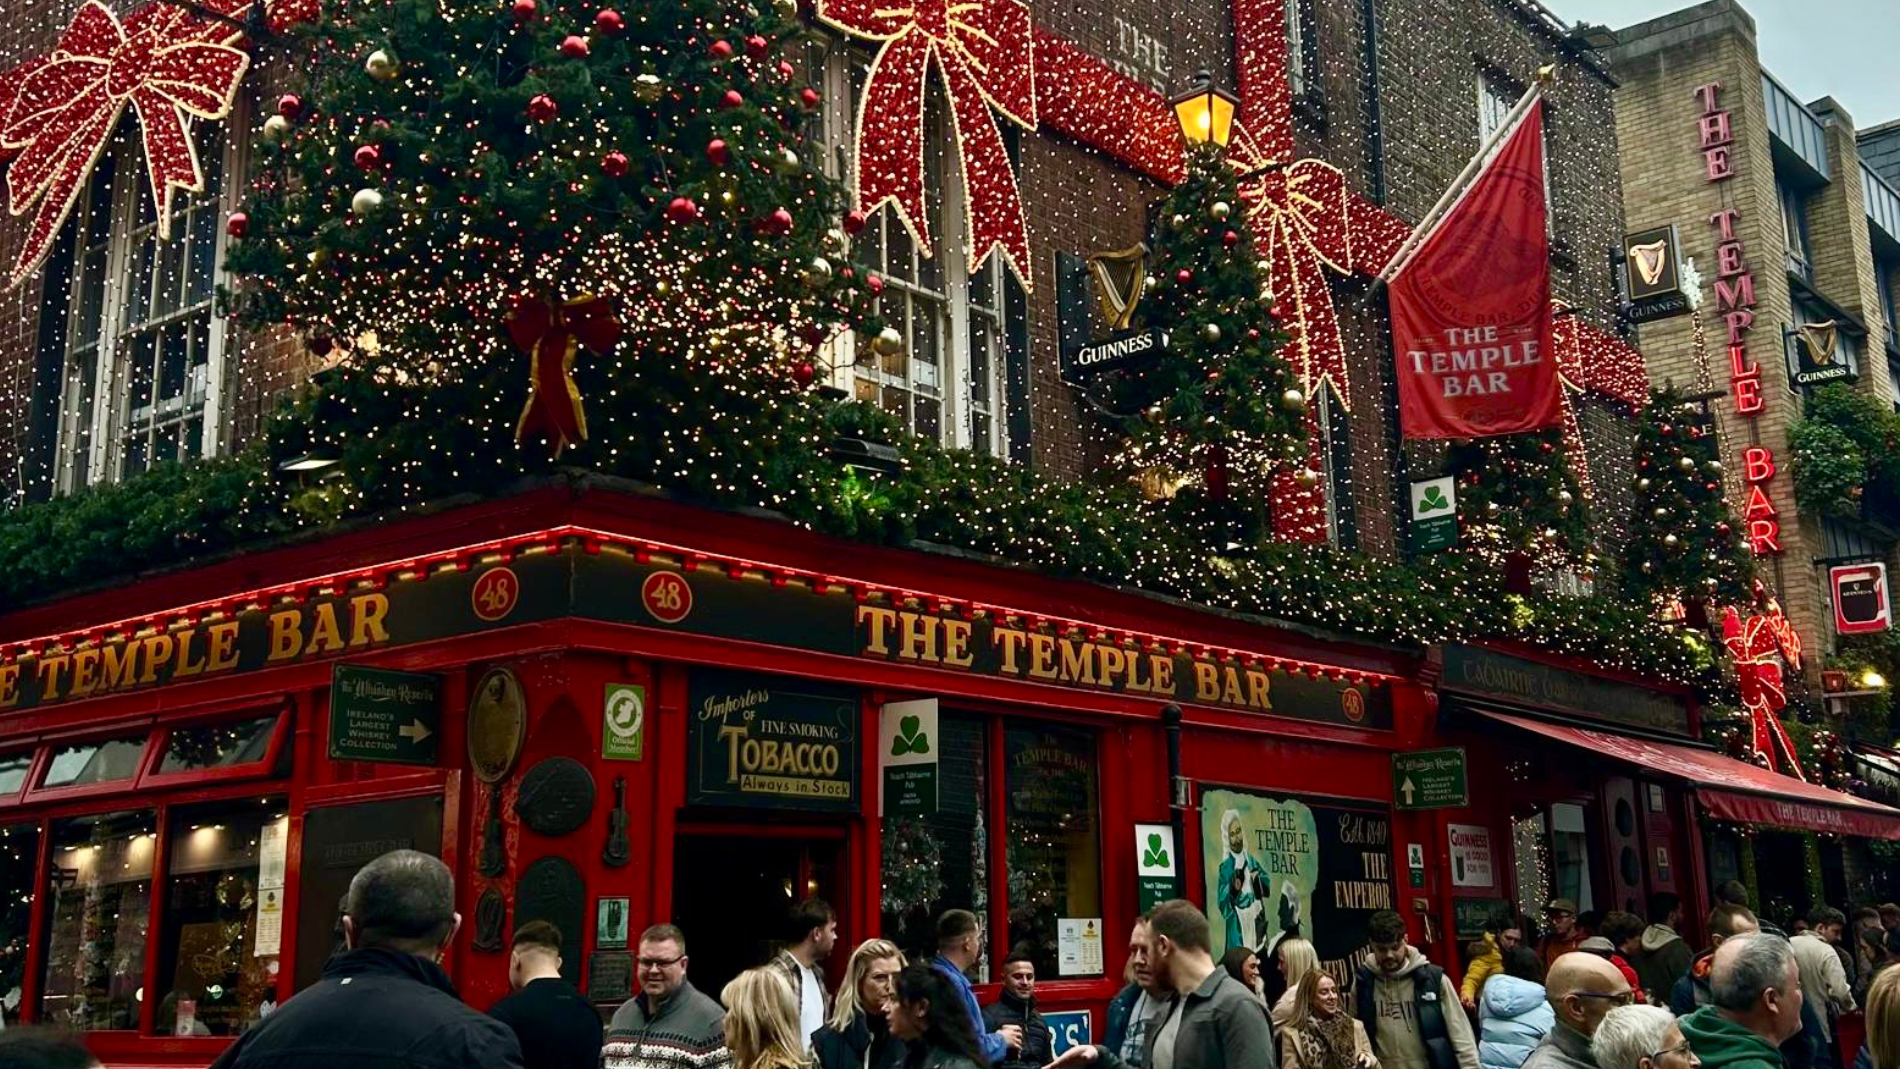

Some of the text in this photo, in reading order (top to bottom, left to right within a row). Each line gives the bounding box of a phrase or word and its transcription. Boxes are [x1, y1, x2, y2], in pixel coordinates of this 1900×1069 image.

[1114, 17, 1170, 80] THE
[1629, 299, 1686, 320] GUINNESS
[1693, 79, 1780, 552] THE TEMPLE BAR
[1444, 325, 1499, 346] THE
[1079, 332, 1153, 366] GUINNESS
[1406, 339, 1542, 374] TEMPLE
[1442, 371, 1512, 398] BAR
[1797, 365, 1847, 384] GUINNESS
[480, 573, 509, 611] 48
[650, 576, 682, 610] 48
[37, 620, 242, 700] TEMPLE
[267, 592, 391, 661] BAR
[858, 604, 1273, 709] THE TEMPLE BAR
[347, 708, 395, 720] IRELAND'S
[698, 688, 769, 724] Importers
[743, 710, 756, 721] OF
[348, 728, 392, 740] WHISKEY
[349, 718, 391, 731] LARGEST
[761, 719, 839, 739] FINE SMOKING
[340, 737, 398, 750] COLLECTION
[717, 725, 840, 784] TOBACCO
[743, 776, 849, 796] Always in Stock
[1267, 808, 1296, 831] THE
[1255, 829, 1310, 854] TEMPLE
[1450, 829, 1488, 849] GUINNESS
[1270, 851, 1299, 876] BAR
[1362, 852, 1388, 880] THE
[1334, 881, 1391, 910] EMPEROR
